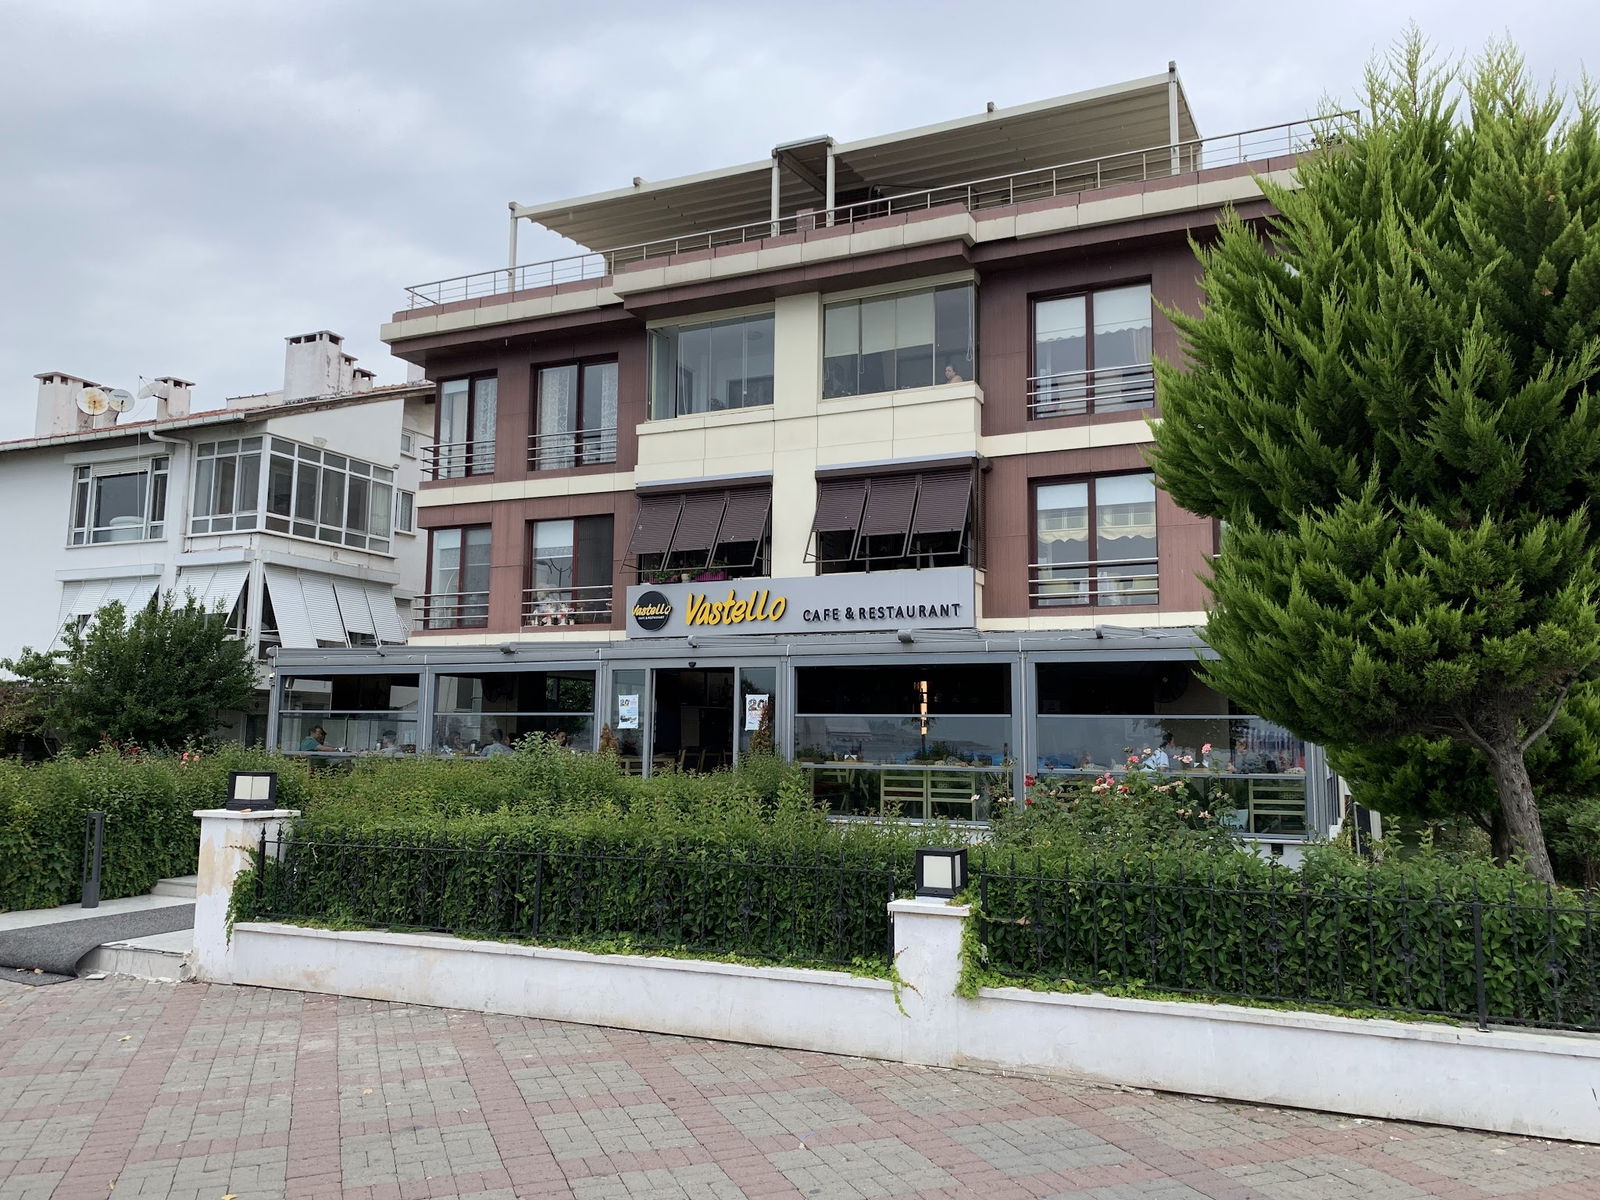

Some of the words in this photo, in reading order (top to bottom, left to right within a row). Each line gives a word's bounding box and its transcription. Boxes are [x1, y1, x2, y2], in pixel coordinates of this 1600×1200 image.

[632, 603, 671, 616] Vastello
[686, 589, 786, 625] Vastello
[803, 608, 839, 622] CAFE
[844, 607, 855, 620] &
[859, 603, 961, 619] RESTAURANT
